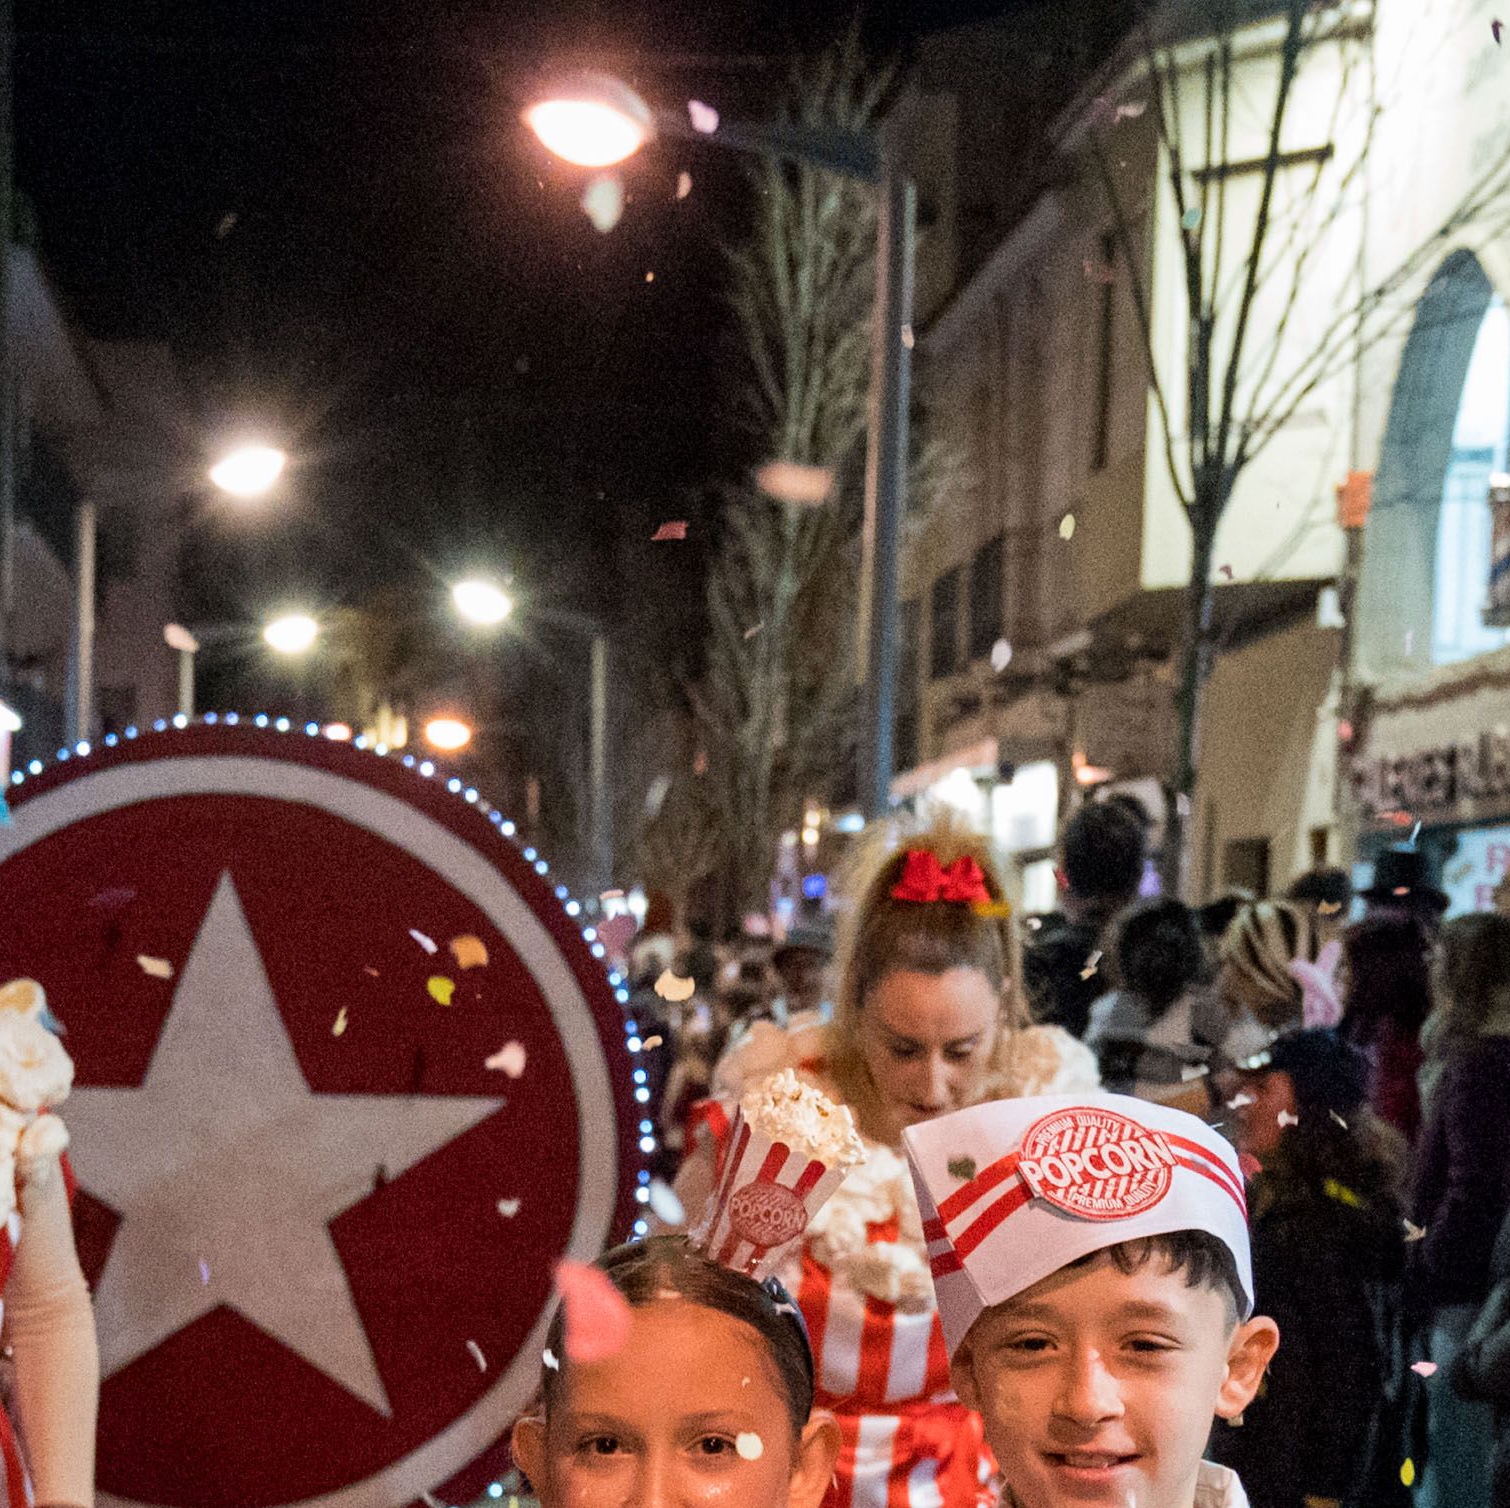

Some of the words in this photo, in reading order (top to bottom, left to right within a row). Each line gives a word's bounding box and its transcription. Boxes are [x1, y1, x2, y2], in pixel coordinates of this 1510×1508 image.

[1035, 1116, 1075, 1146] PREMIUM
[1077, 1115, 1120, 1131] QUALITY
[1018, 1132, 1178, 1193] POPCORN
[1070, 1192, 1124, 1210] PREMIUM
[1123, 1177, 1157, 1206] QUALITY
